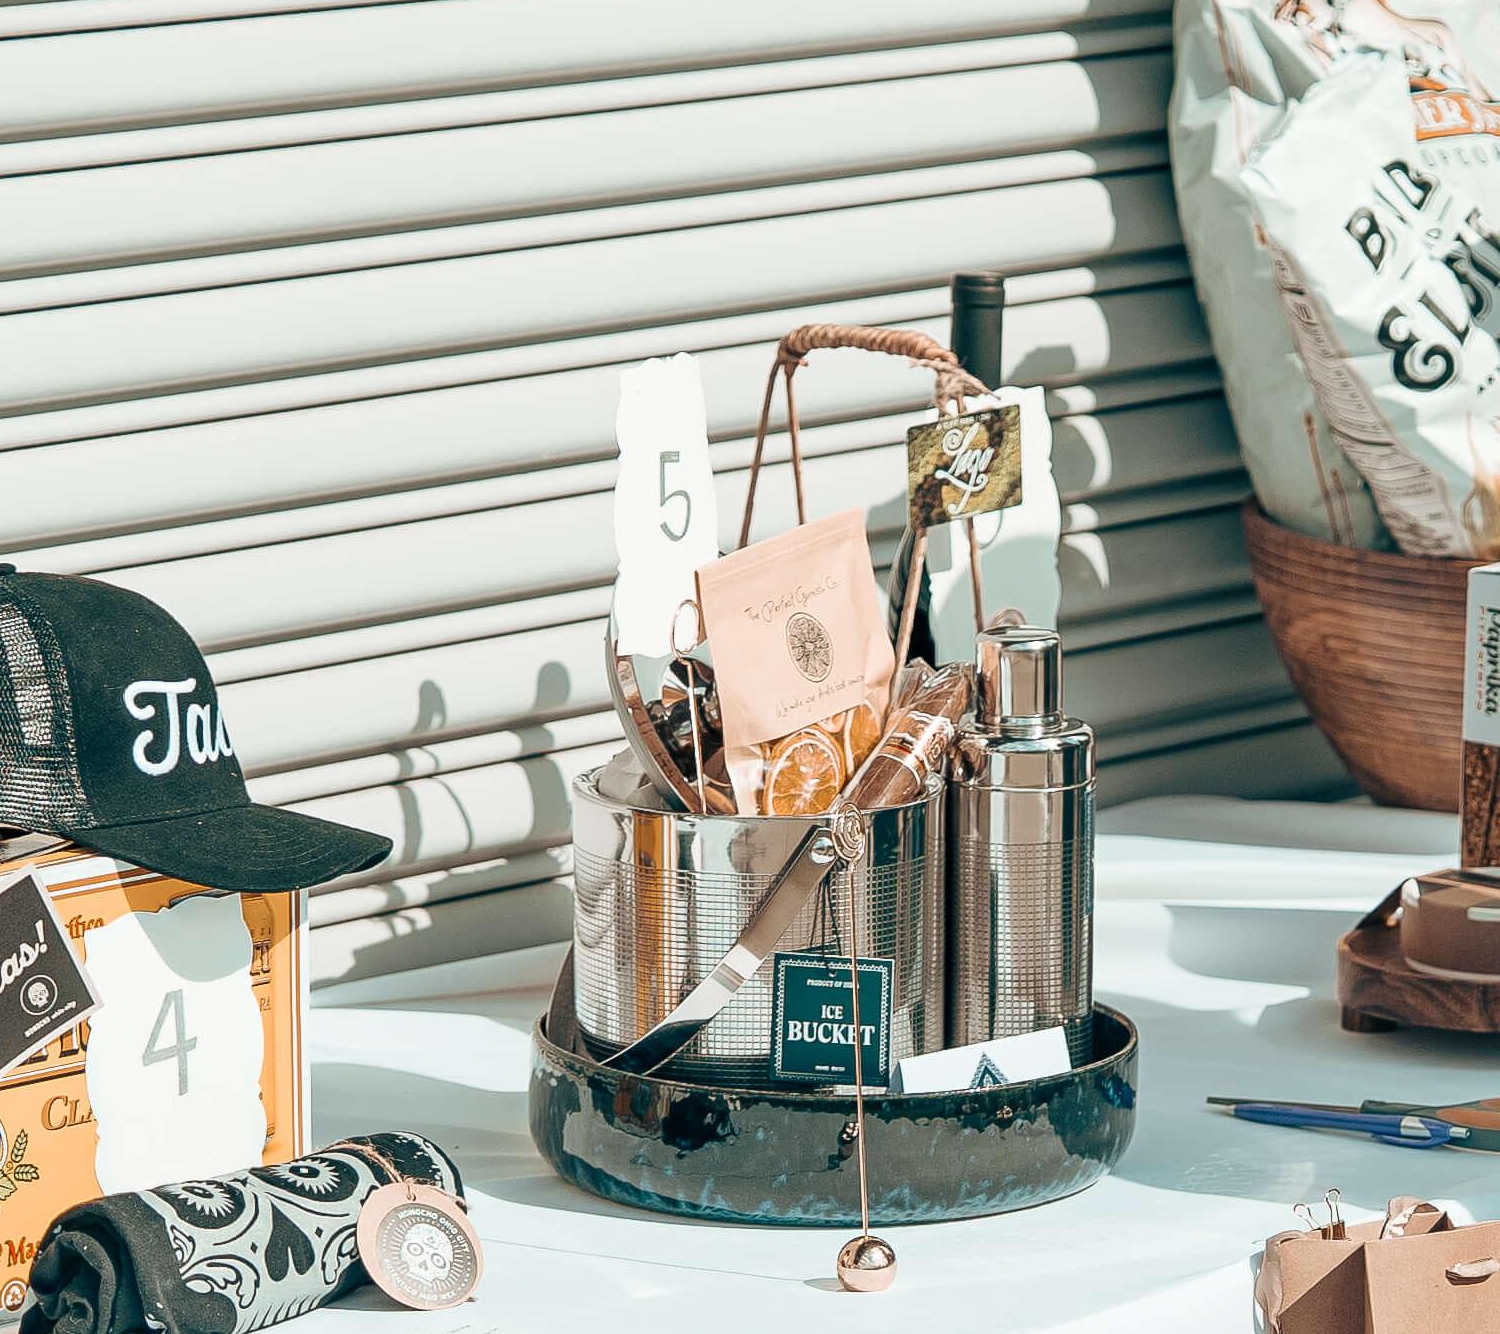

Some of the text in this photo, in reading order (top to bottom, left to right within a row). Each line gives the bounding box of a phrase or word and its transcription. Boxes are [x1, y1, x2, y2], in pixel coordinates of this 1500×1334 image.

[658, 450, 693, 542] 5
[786, 1020, 876, 1046] BUCKET
[821, 1004, 844, 1020] ICE
[141, 988, 198, 1097] 4
